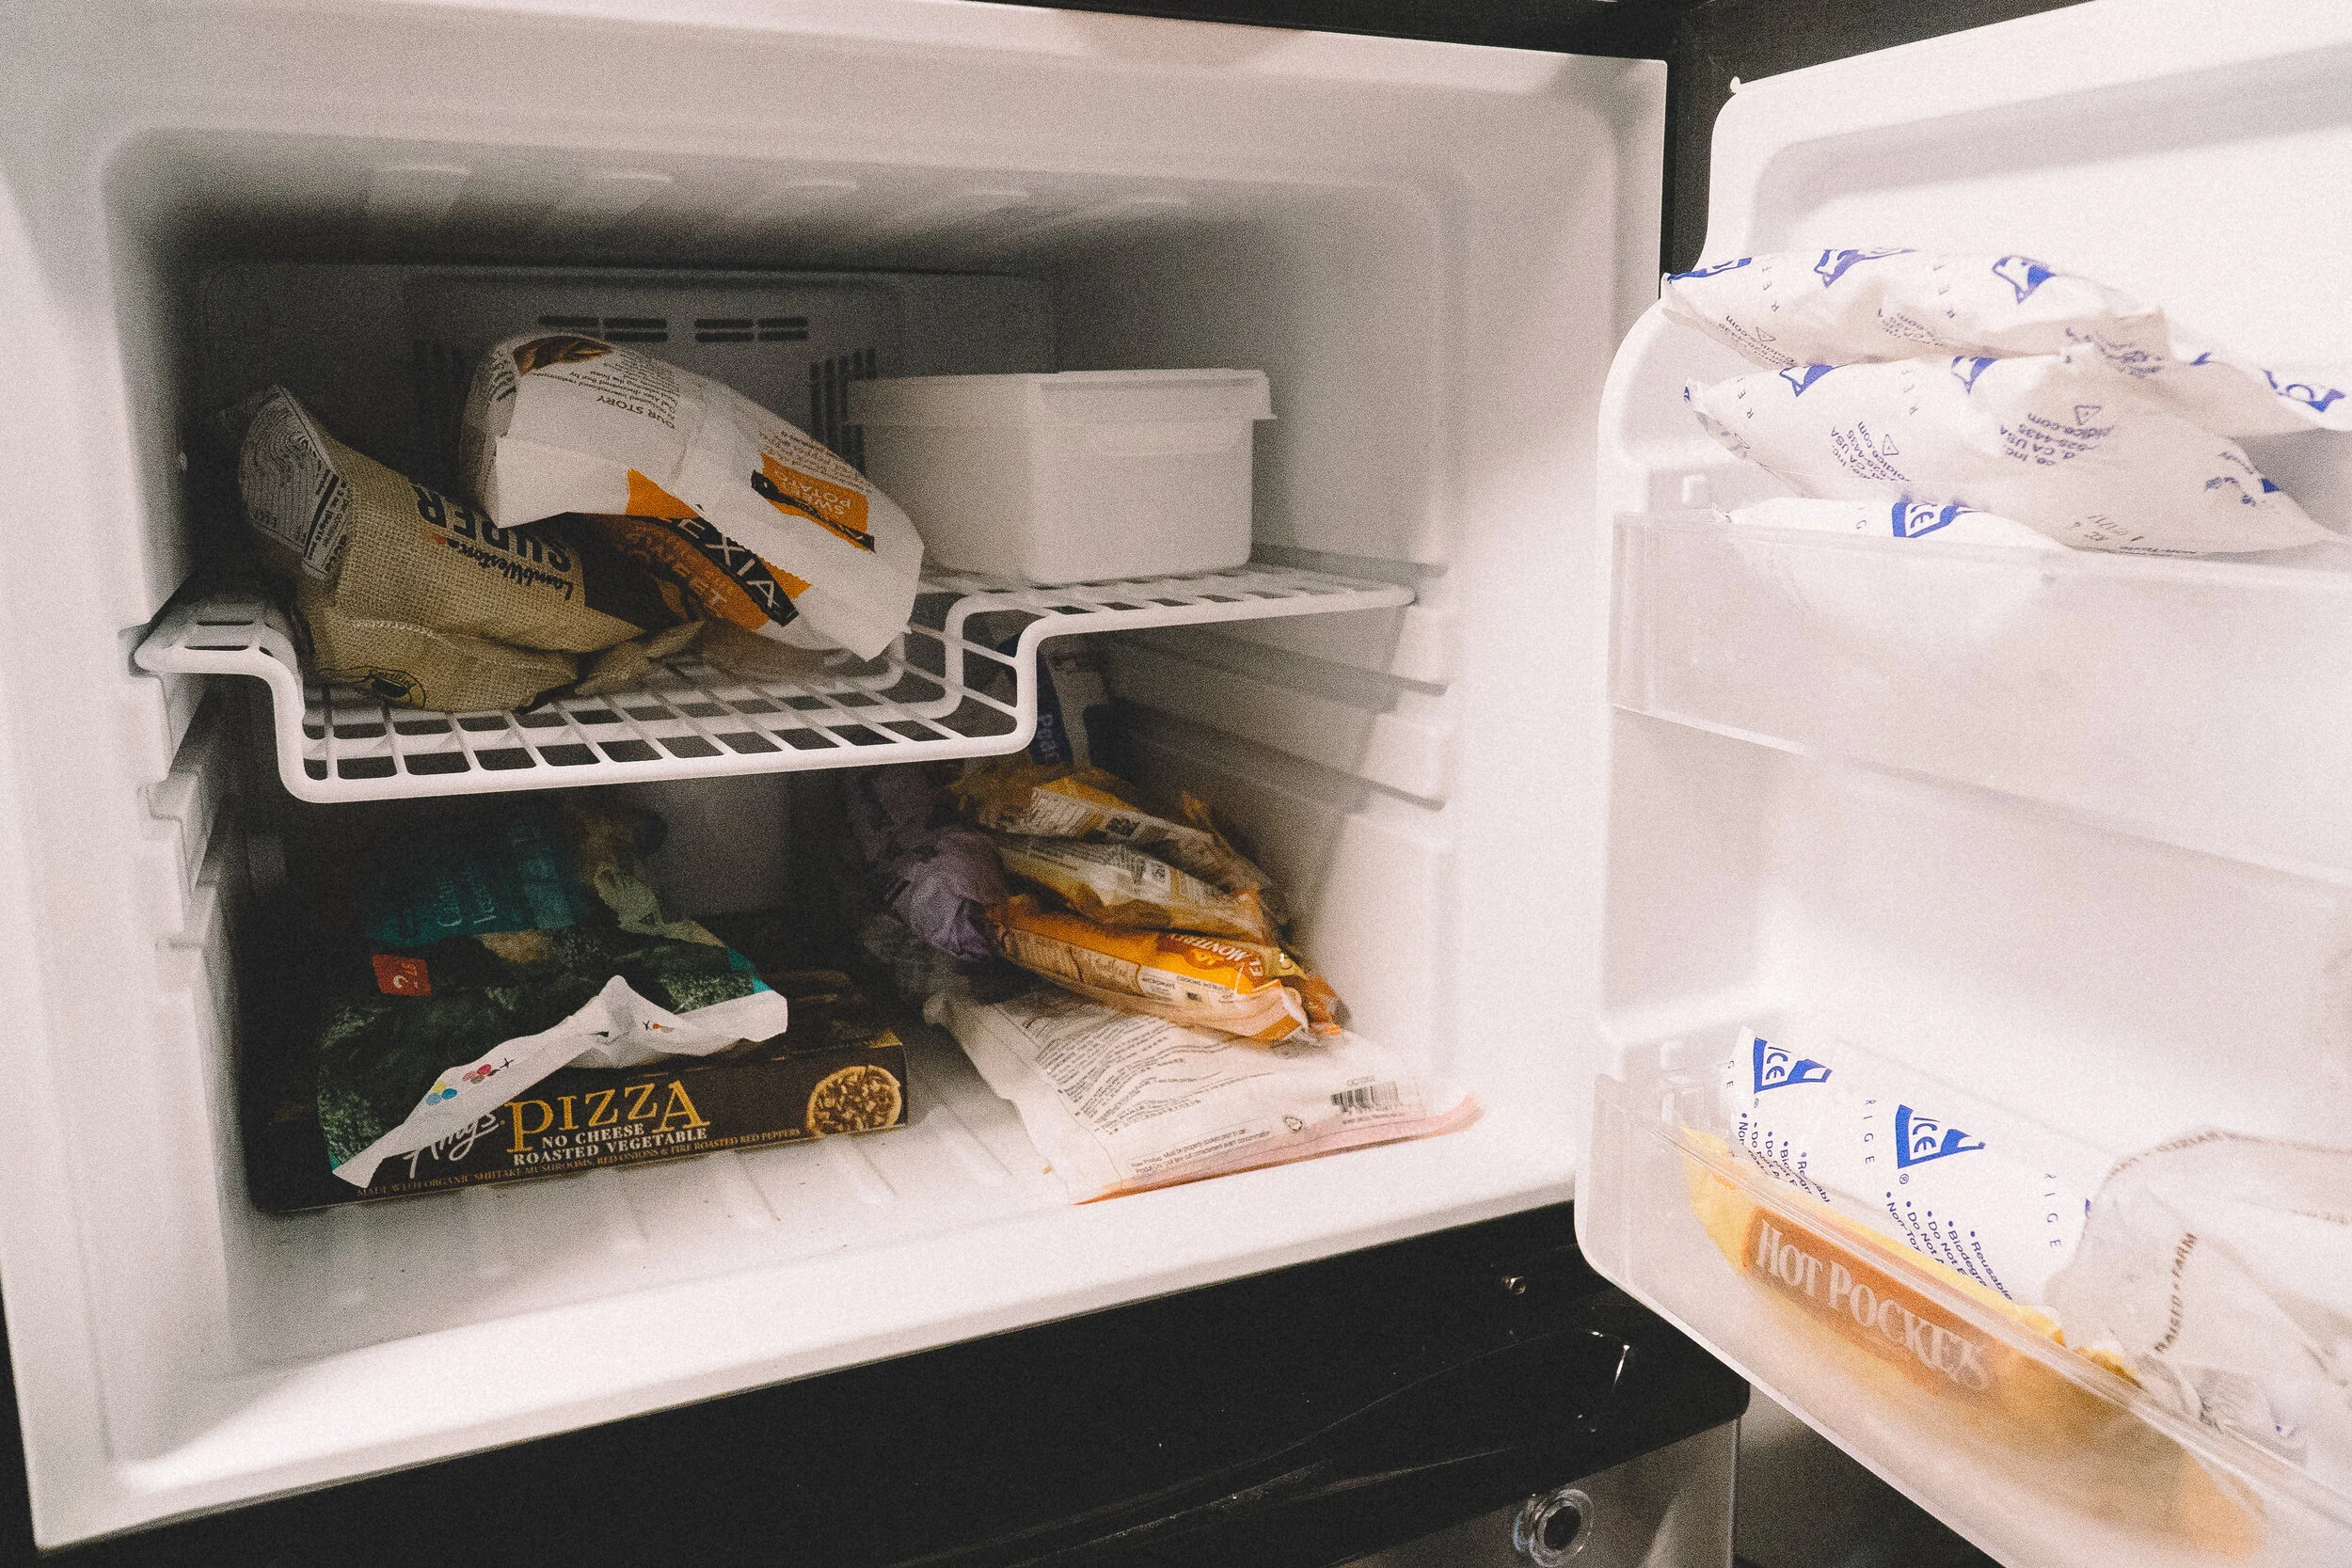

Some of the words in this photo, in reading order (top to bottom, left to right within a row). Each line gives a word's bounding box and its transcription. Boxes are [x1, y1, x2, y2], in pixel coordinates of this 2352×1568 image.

[569, 371, 580, 379] by
[596, 394, 644, 415] STORY
[647, 409, 675, 429] OUR
[1830, 425, 1851, 454] USA
[1998, 423, 2028, 450] USA
[2032, 443, 2056, 457] CA
[771, 468, 852, 509] POTATO
[777, 480, 847, 516] SWEET
[410, 484, 569, 574] SUPER
[457, 542, 575, 602] LambWeston
[676, 514, 782, 608] EXIA
[1765, 1046, 1792, 1081] ICE
[500, 1081, 712, 1154] PIZZA
[541, 1132, 570, 1150] NO
[574, 1122, 645, 1145] CHEESE
[1912, 1117, 1941, 1153] ICE
[422, 1174, 469, 1190] ORGANIC
[596, 1153, 619, 1165] RED
[618, 1148, 660, 1163] ONIONS
[670, 1143, 692, 1155] FIRE
[693, 1136, 739, 1151] ROASTED
[739, 1132, 760, 1145] RED
[761, 1127, 802, 1141] PEPPERS
[513, 1142, 600, 1167] ROASTED
[607, 1127, 708, 1153] VEGETABLE
[1764, 1140, 1774, 1158] Do
[1886, 1201, 1922, 1253] Non-Tox
[1907, 1212, 1920, 1230] Do
[1920, 1232, 1937, 1255] Not
[1928, 1220, 1941, 1240] Do
[1941, 1242, 1958, 1265] Not
[1971, 1241, 2013, 1301] Reusable
[2169, 1230, 2199, 1278] FARM
[1756, 1221, 1826, 1300] HOT
[1828, 1258, 1992, 1394] POCKETS
